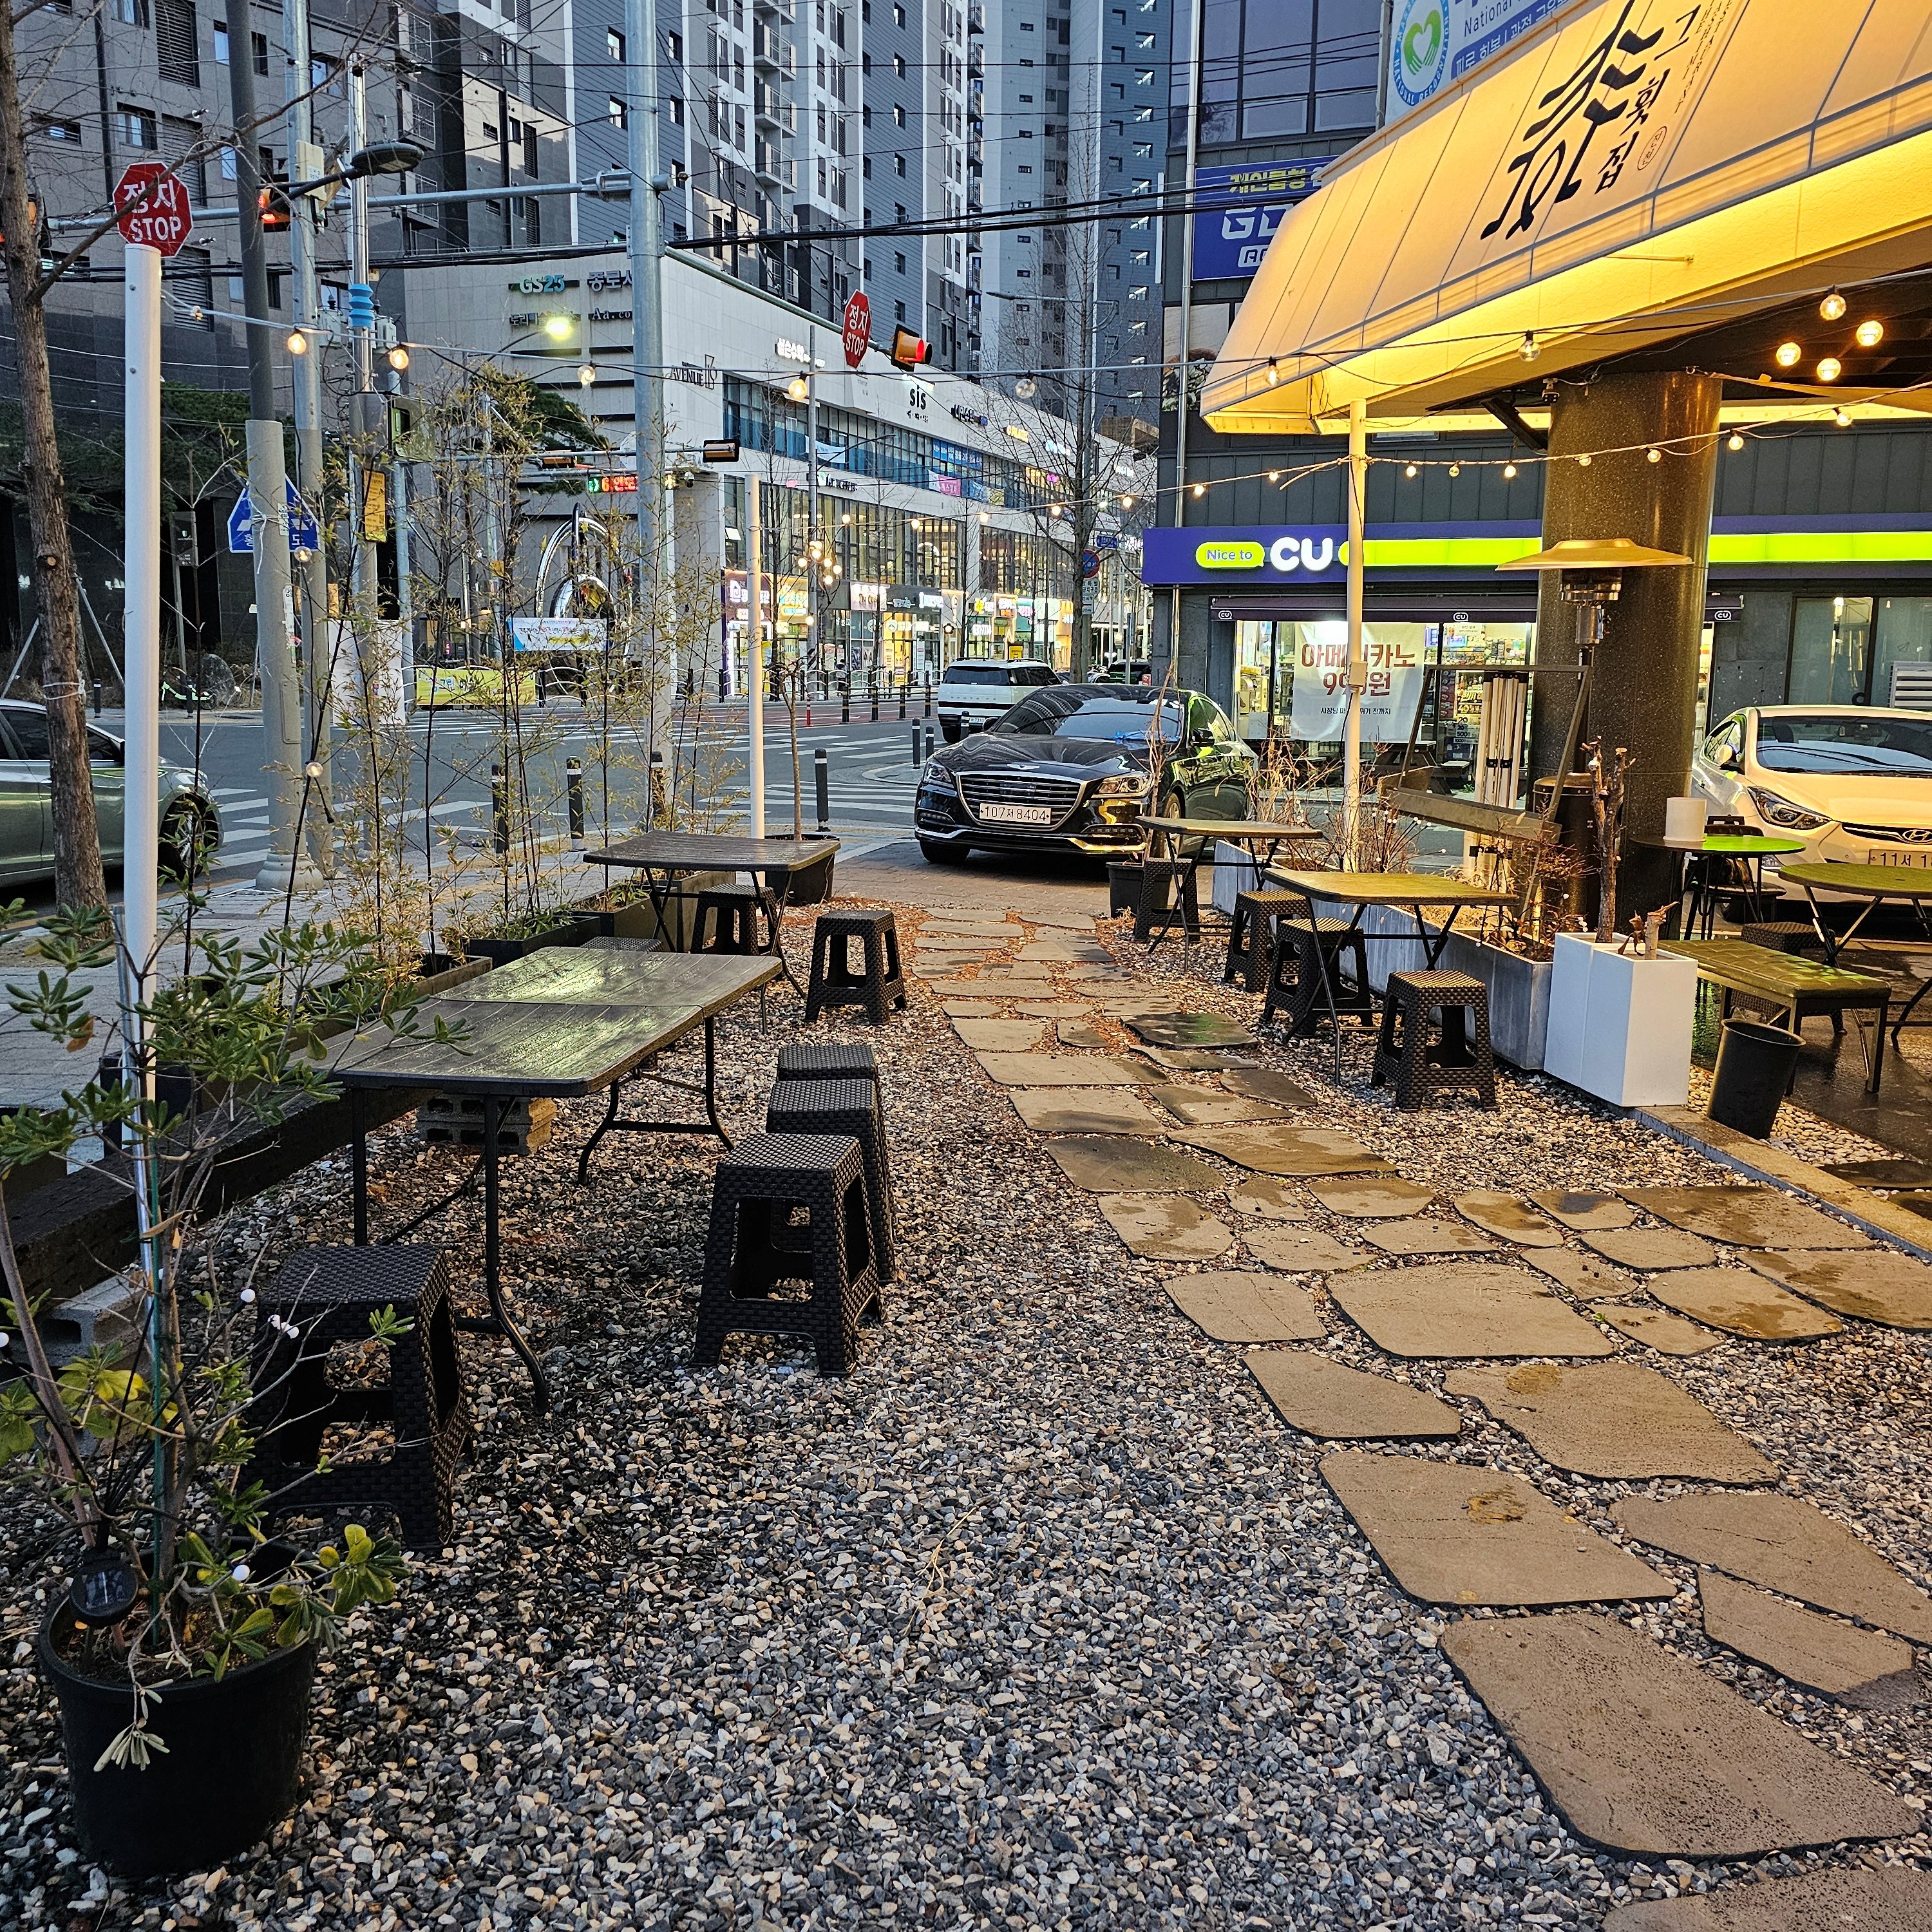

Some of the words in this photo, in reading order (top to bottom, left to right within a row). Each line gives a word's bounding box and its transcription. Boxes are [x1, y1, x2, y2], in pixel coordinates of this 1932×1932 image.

[1464, 0, 1512, 37] National
[1682, 1, 1722, 80] ASHIMI
[124, 180, 177, 214] 정지
[129, 216, 182, 242] STOP
[520, 274, 565, 294] GS25
[592, 308, 633, 320] Aa.co
[849, 304, 868, 336] 정지
[846, 332, 864, 356] STOP
[1207, 549, 1236, 560] Nice
[1240, 550, 1253, 560] to
[1270, 536, 1333, 571] CU
[1302, 644, 1416, 668] 아메카노
[1880, 852, 1911, 867] 11서
